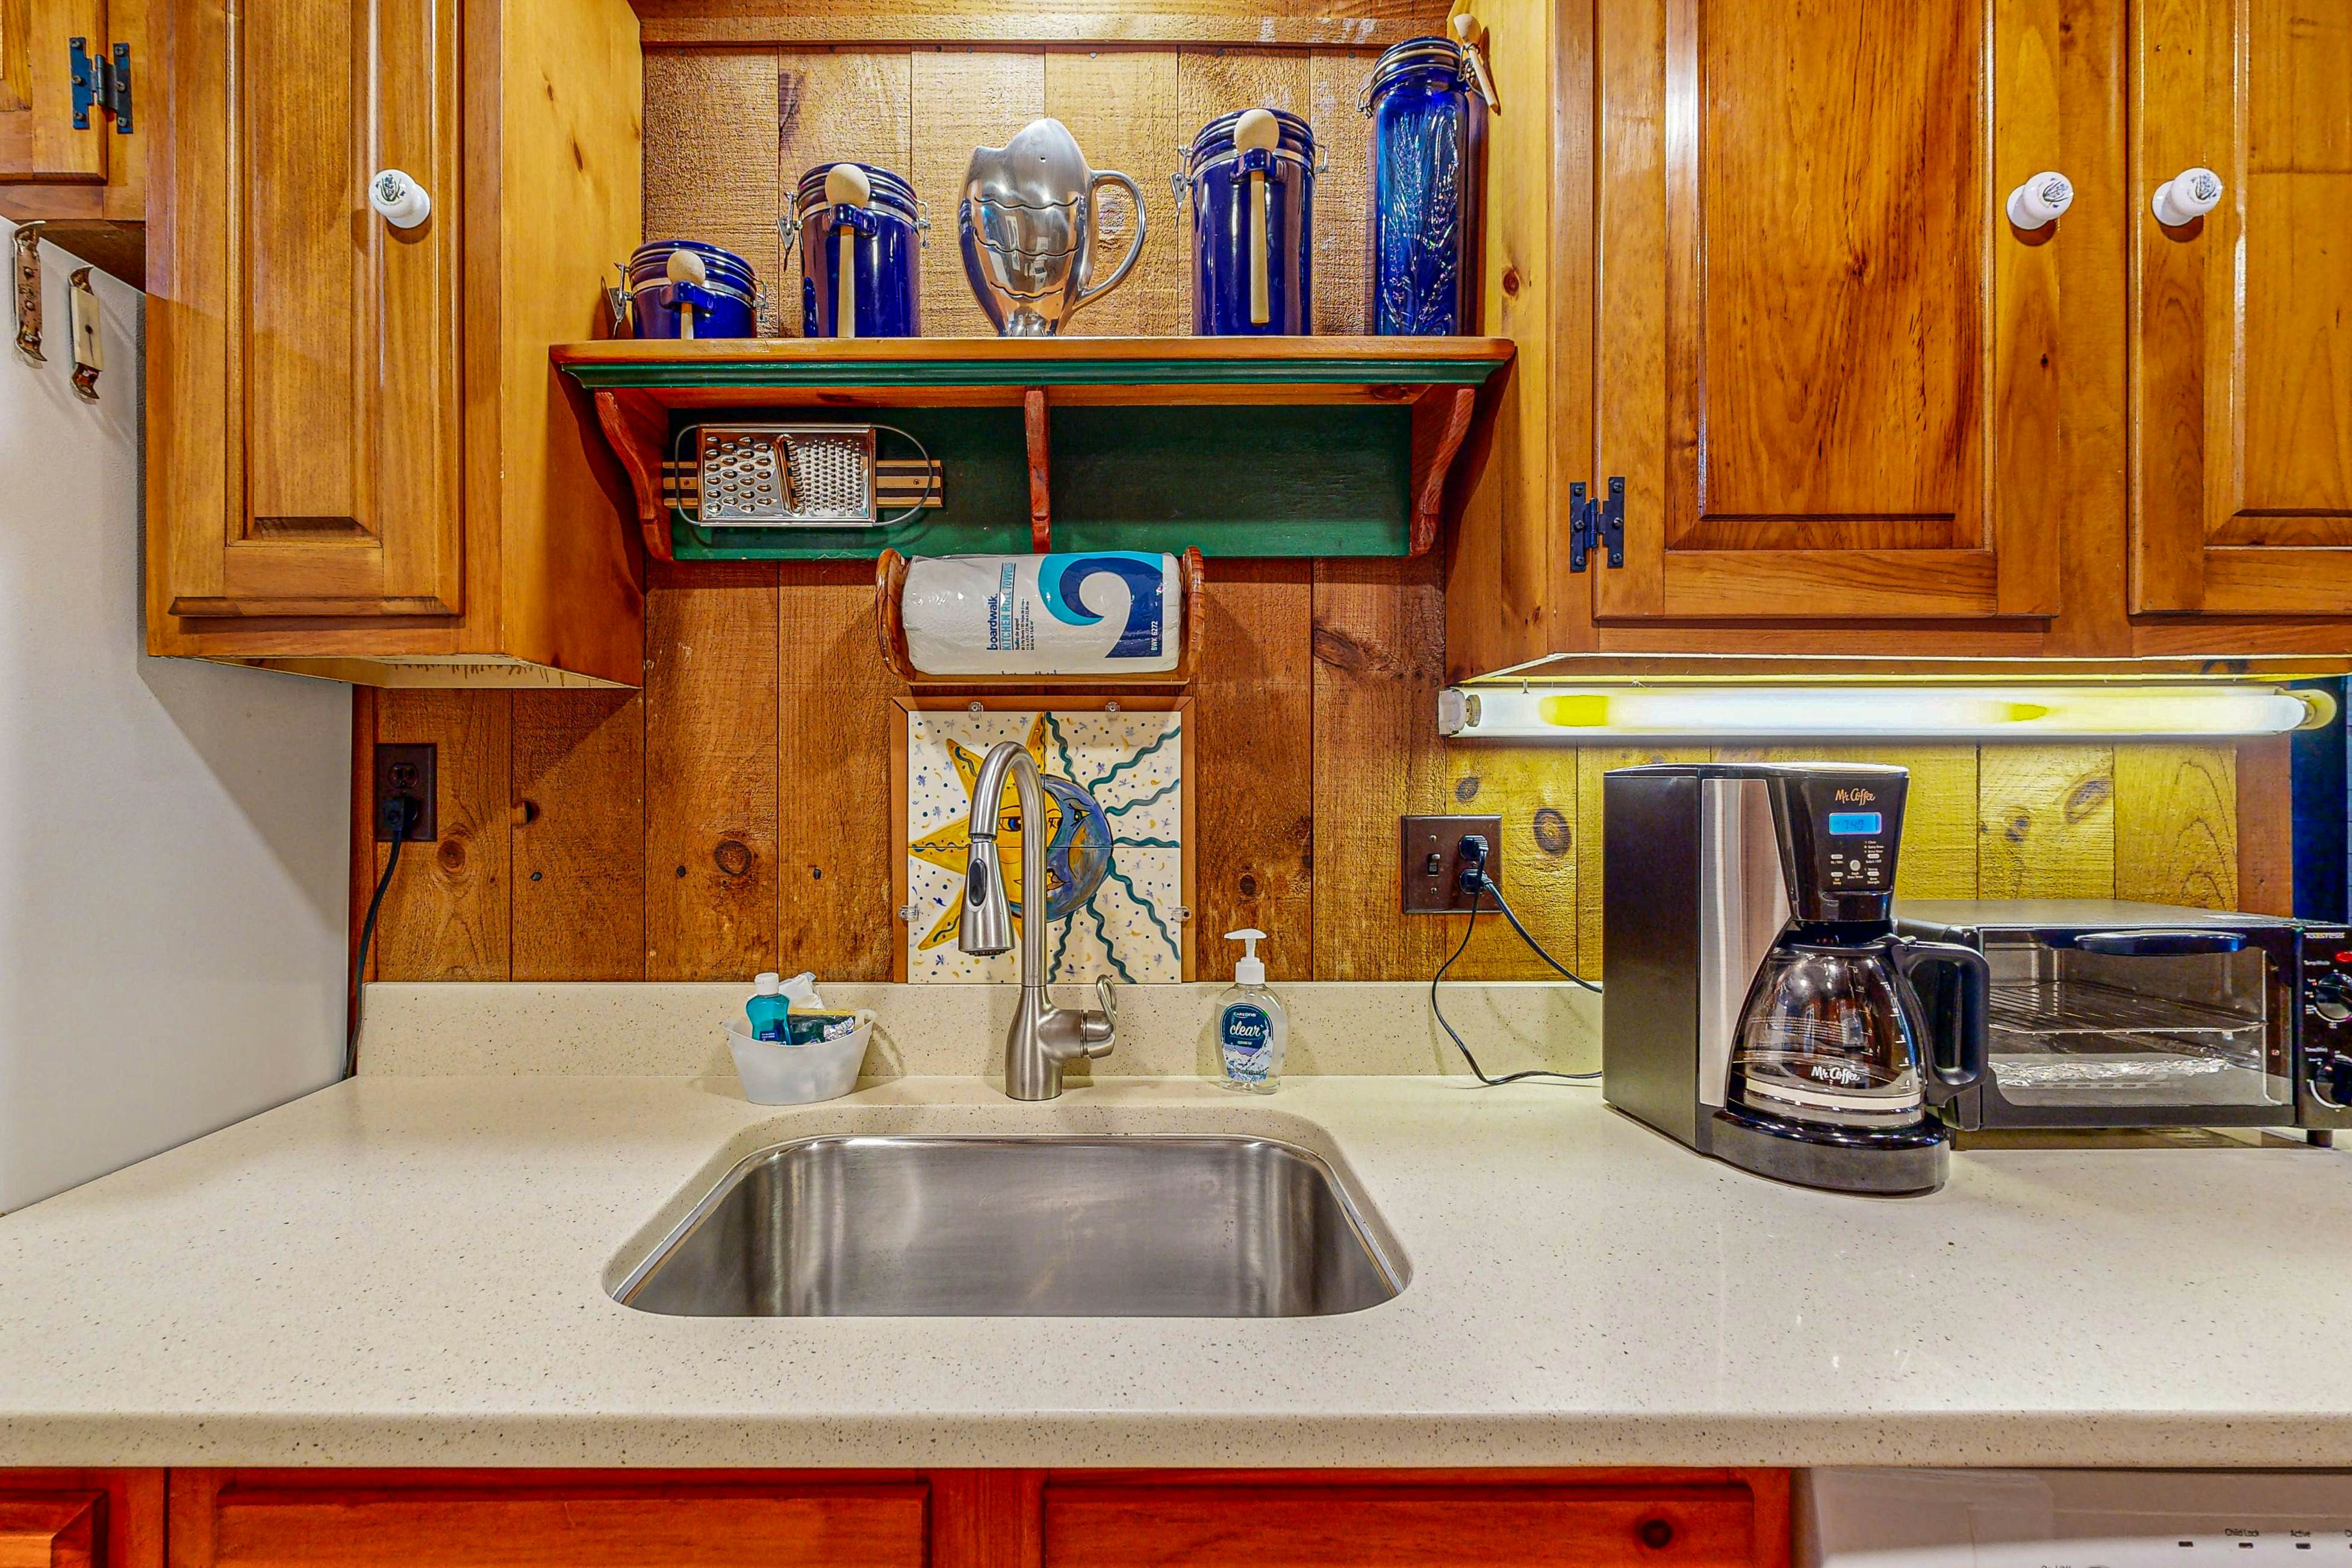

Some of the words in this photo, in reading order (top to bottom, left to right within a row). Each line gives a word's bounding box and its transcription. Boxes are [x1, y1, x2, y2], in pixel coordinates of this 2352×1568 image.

[1002, 562, 1013, 590] TOWELS
[1001, 614, 1012, 651] KITCHEN
[1850, 788, 1876, 806] Coffee
[1230, 1021, 1261, 1037] clear
[1829, 1067, 1860, 1084] Coffee
[2224, 1528, 2243, 1537] Child
[2244, 1528, 2259, 1537] Lock
